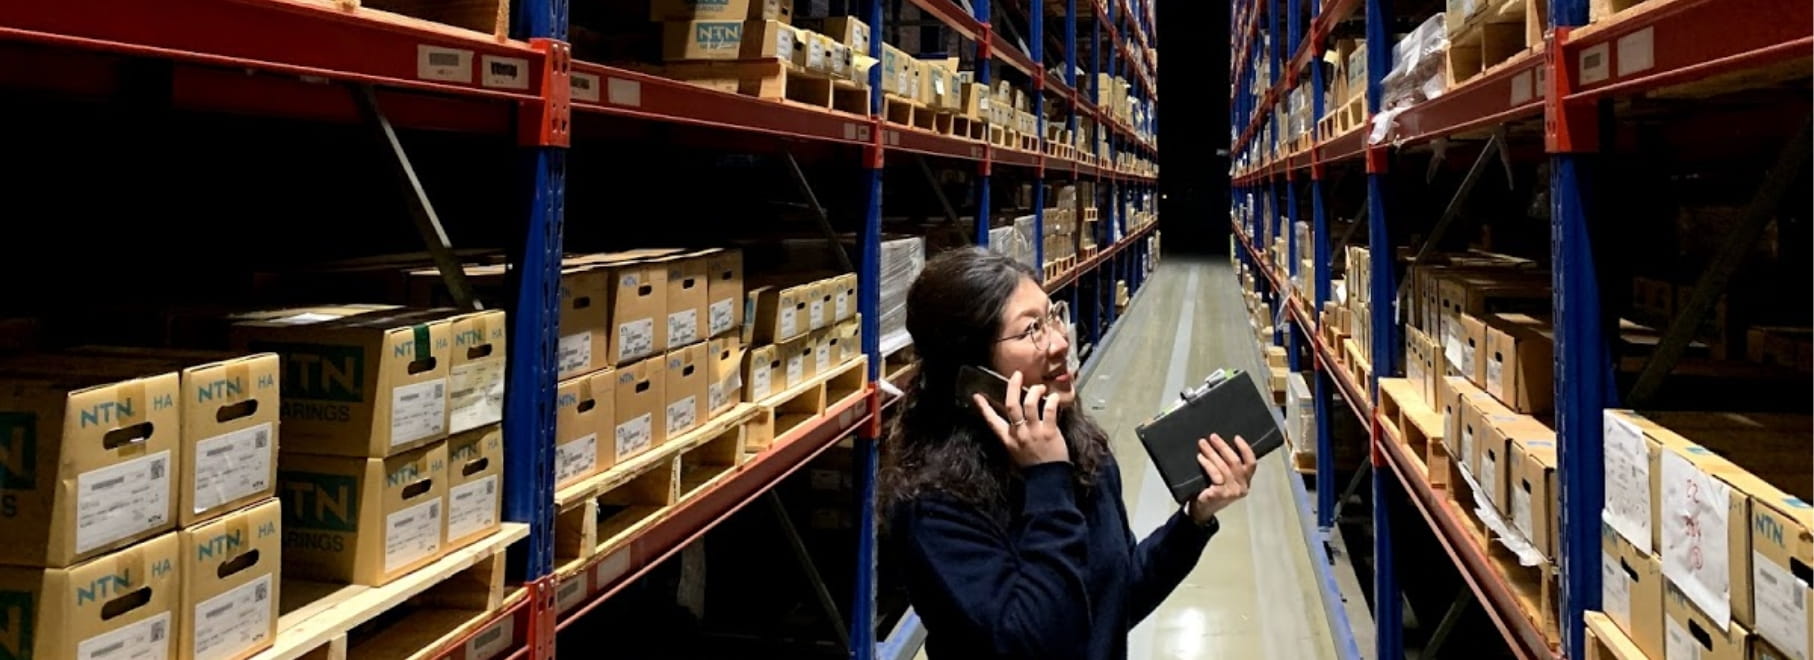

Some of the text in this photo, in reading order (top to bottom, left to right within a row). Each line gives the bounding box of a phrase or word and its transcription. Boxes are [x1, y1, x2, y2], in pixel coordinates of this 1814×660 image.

[698, 26, 739, 41] NTN
[435, 338, 448, 351] HA
[455, 328, 482, 347] NTN
[197, 373, 274, 403] NTN HA
[282, 352, 358, 396] TN
[80, 393, 173, 428] NTN HA
[559, 394, 576, 408] NTN
[452, 443, 478, 463] NTN
[387, 459, 443, 488] NTN HA
[284, 480, 350, 526] TN
[147, 514, 162, 524] NTN
[1755, 514, 1784, 545] NTN
[198, 520, 275, 561] NTN HA
[77, 558, 172, 606] NTN HA
